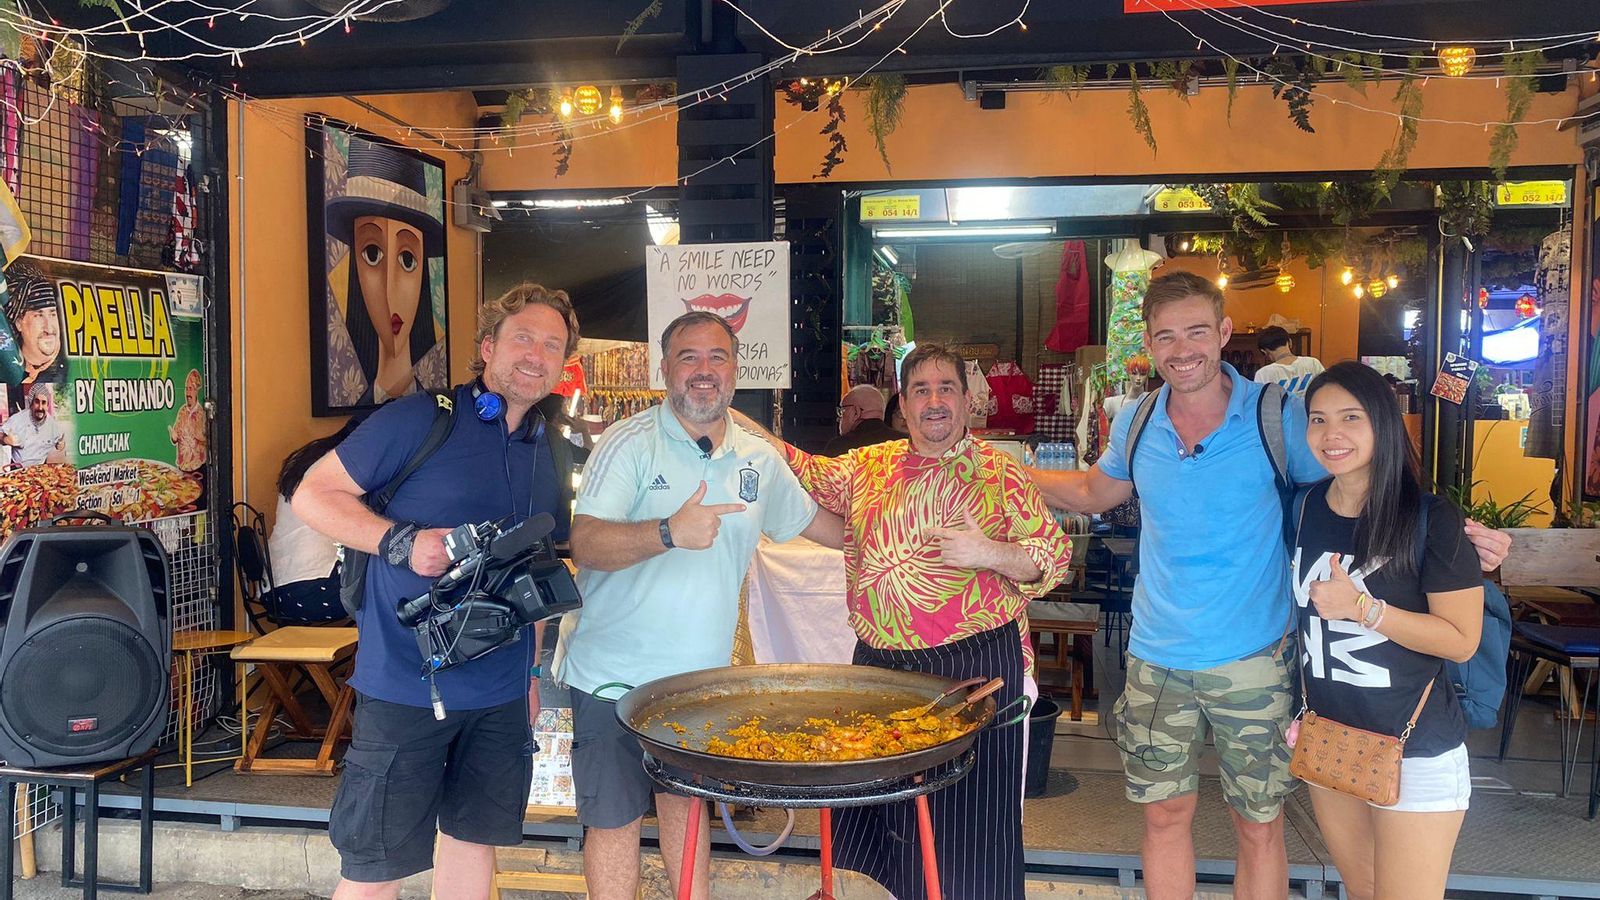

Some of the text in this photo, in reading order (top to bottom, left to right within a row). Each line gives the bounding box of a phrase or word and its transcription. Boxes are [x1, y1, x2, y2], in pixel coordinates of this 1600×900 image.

[1162, 200, 1169, 209] 8
[1177, 200, 1195, 208] 053
[1522, 194, 1540, 202] 052
[1545, 193, 1564, 201] 14/1
[867, 209, 874, 217] 8
[882, 209, 898, 217] 054
[678, 249, 725, 274] SMILE
[731, 248, 776, 271] NEED
[677, 270, 778, 292] NO WORDS"
[59, 282, 176, 358] PAELLA
[736, 342, 769, 361] RISA
[75, 377, 176, 414] BY FERNANDO
[78, 431, 131, 455] CHATUCHAK
[78, 464, 137, 487] Weekend Market
[76, 494, 103, 511] Section
[111, 490, 124, 506] Soi
